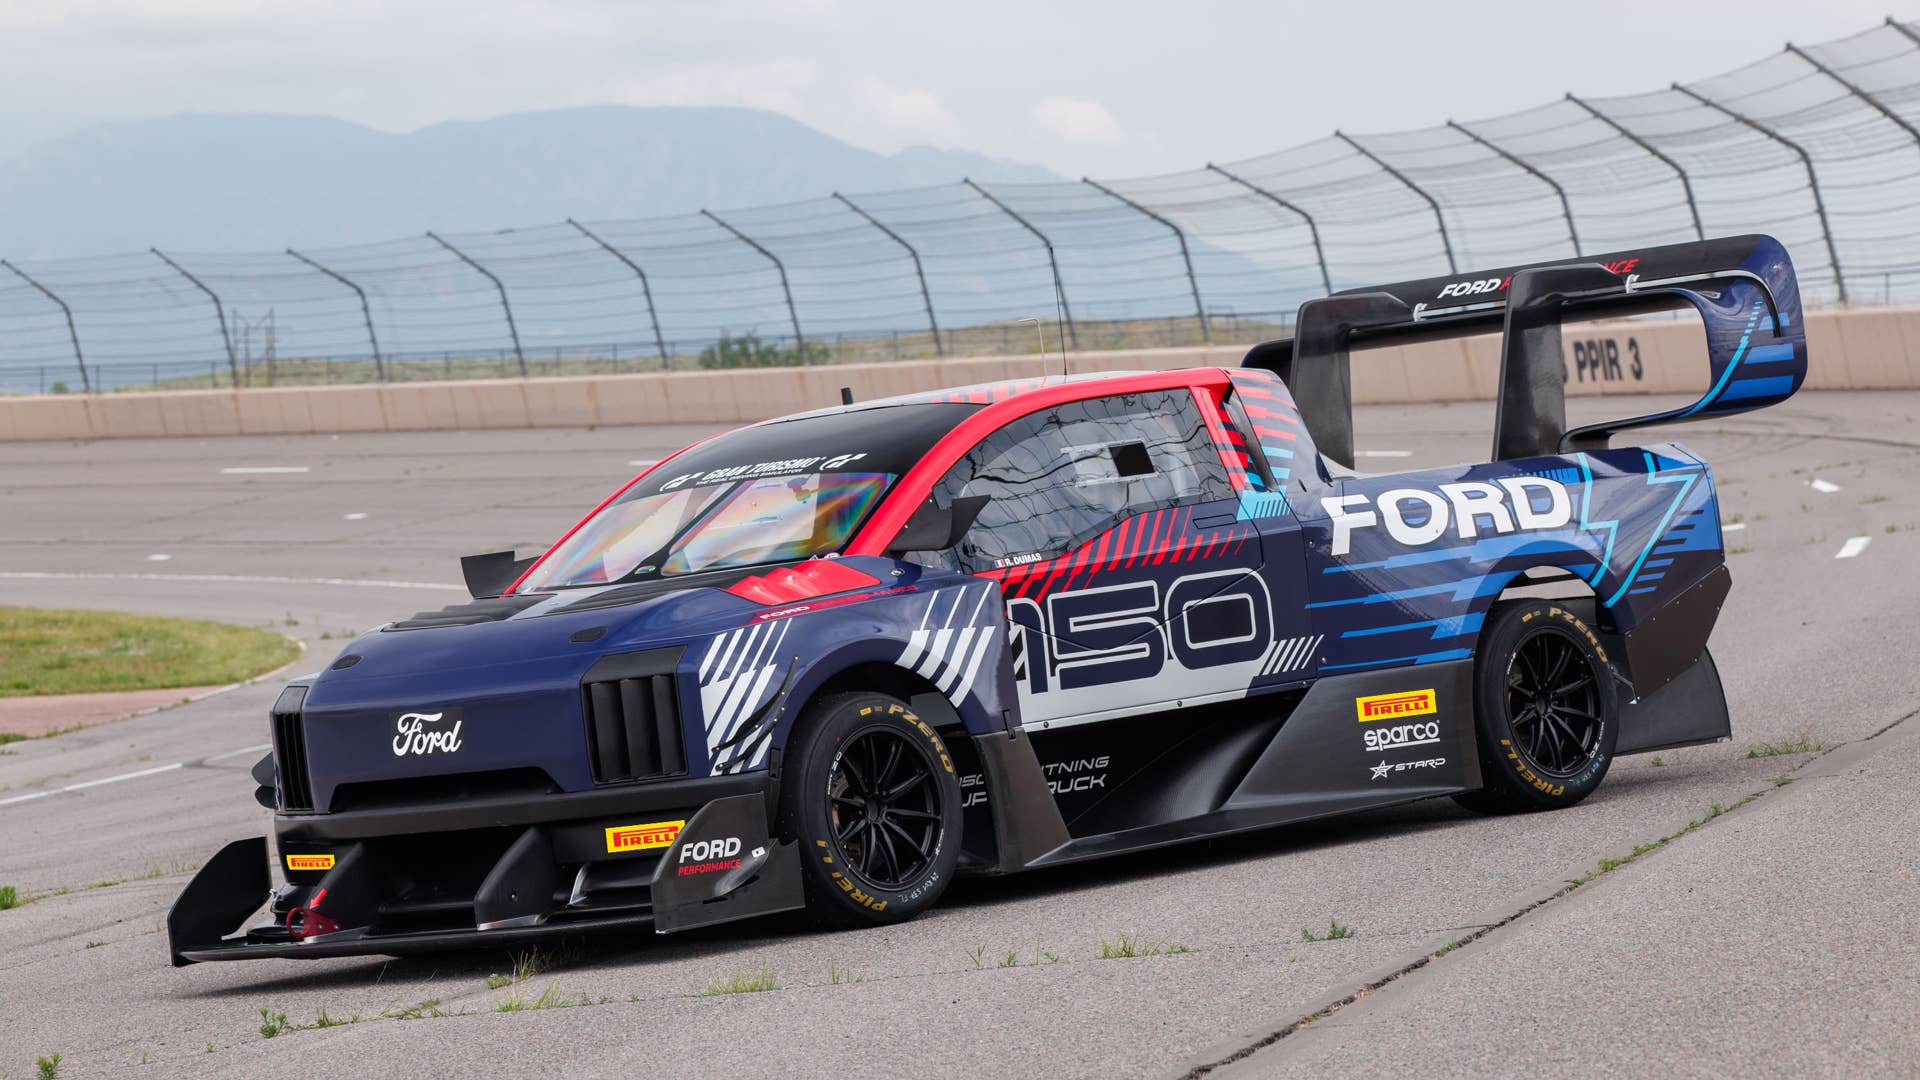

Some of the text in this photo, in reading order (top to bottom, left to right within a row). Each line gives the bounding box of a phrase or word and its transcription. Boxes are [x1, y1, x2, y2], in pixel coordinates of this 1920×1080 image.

[1437, 278, 1502, 299] FORD
[1573, 338, 1622, 383] PPIR
[1628, 337, 1643, 381] 3
[702, 457, 820, 481] GRAN TURISMO
[1320, 476, 1572, 556] FORD
[1004, 552, 1042, 567] R. DUMAS
[759, 606, 810, 619] FORD
[1363, 694, 1429, 716] PIRELLI
[392, 712, 463, 756] Ford
[1363, 722, 1439, 751] sparco
[1395, 758, 1446, 771] STARD
[1500, 739, 1565, 796] PIRELLI
[613, 826, 679, 848] PIRELLI
[679, 837, 742, 864] FORD
[291, 858, 331, 868] PIRELLI
[678, 859, 741, 877] PERFORMANCE
